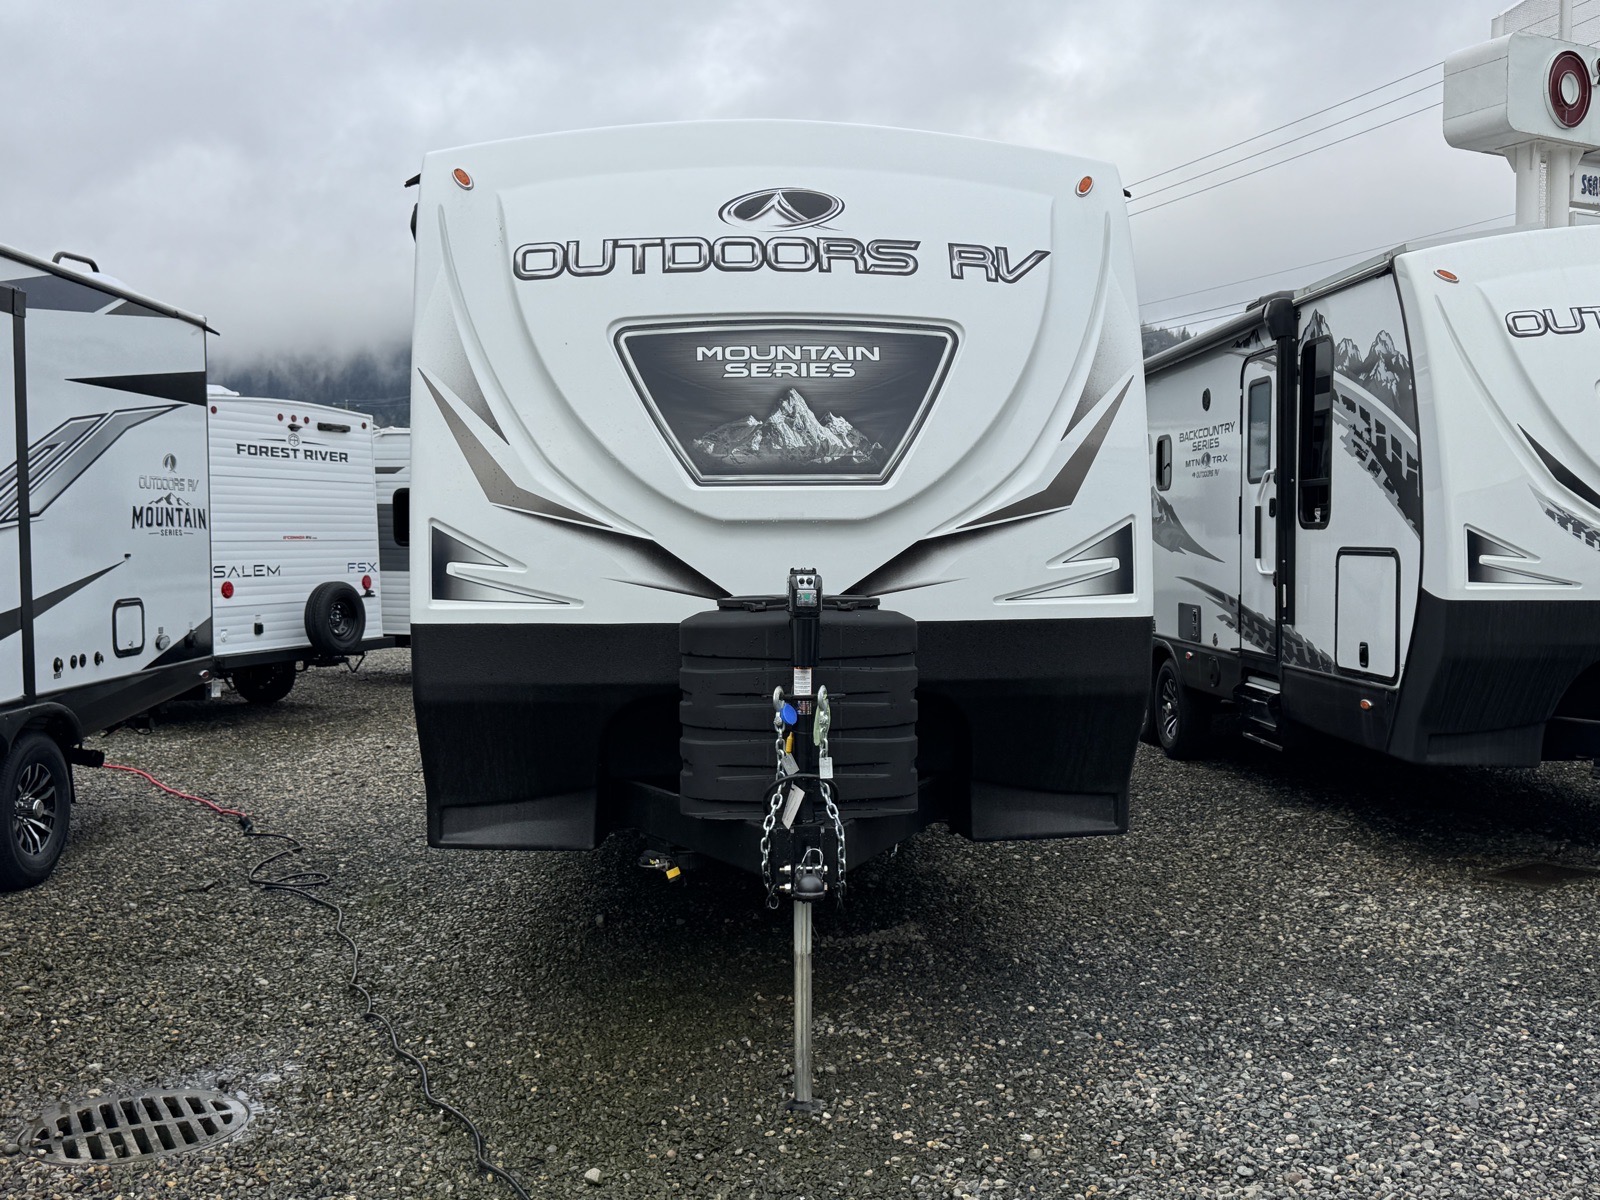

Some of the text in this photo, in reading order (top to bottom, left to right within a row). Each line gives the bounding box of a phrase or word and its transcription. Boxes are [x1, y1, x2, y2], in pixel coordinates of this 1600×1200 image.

[513, 236, 1051, 284] OUTDOORS RV
[696, 345, 881, 361] MOUNTAIN
[722, 362, 856, 378] SERIES
[1179, 421, 1236, 443] BACKCOUNTRY
[1192, 437, 1220, 452] SERIES
[236, 443, 349, 463] FOREST RIVER
[1185, 454, 1228, 468] MTN TRX
[139, 475, 200, 492] OUTDOORS RV
[132, 505, 207, 530] MOUNTAIN
[213, 564, 281, 578] SALEM
[347, 562, 377, 573] FSX
